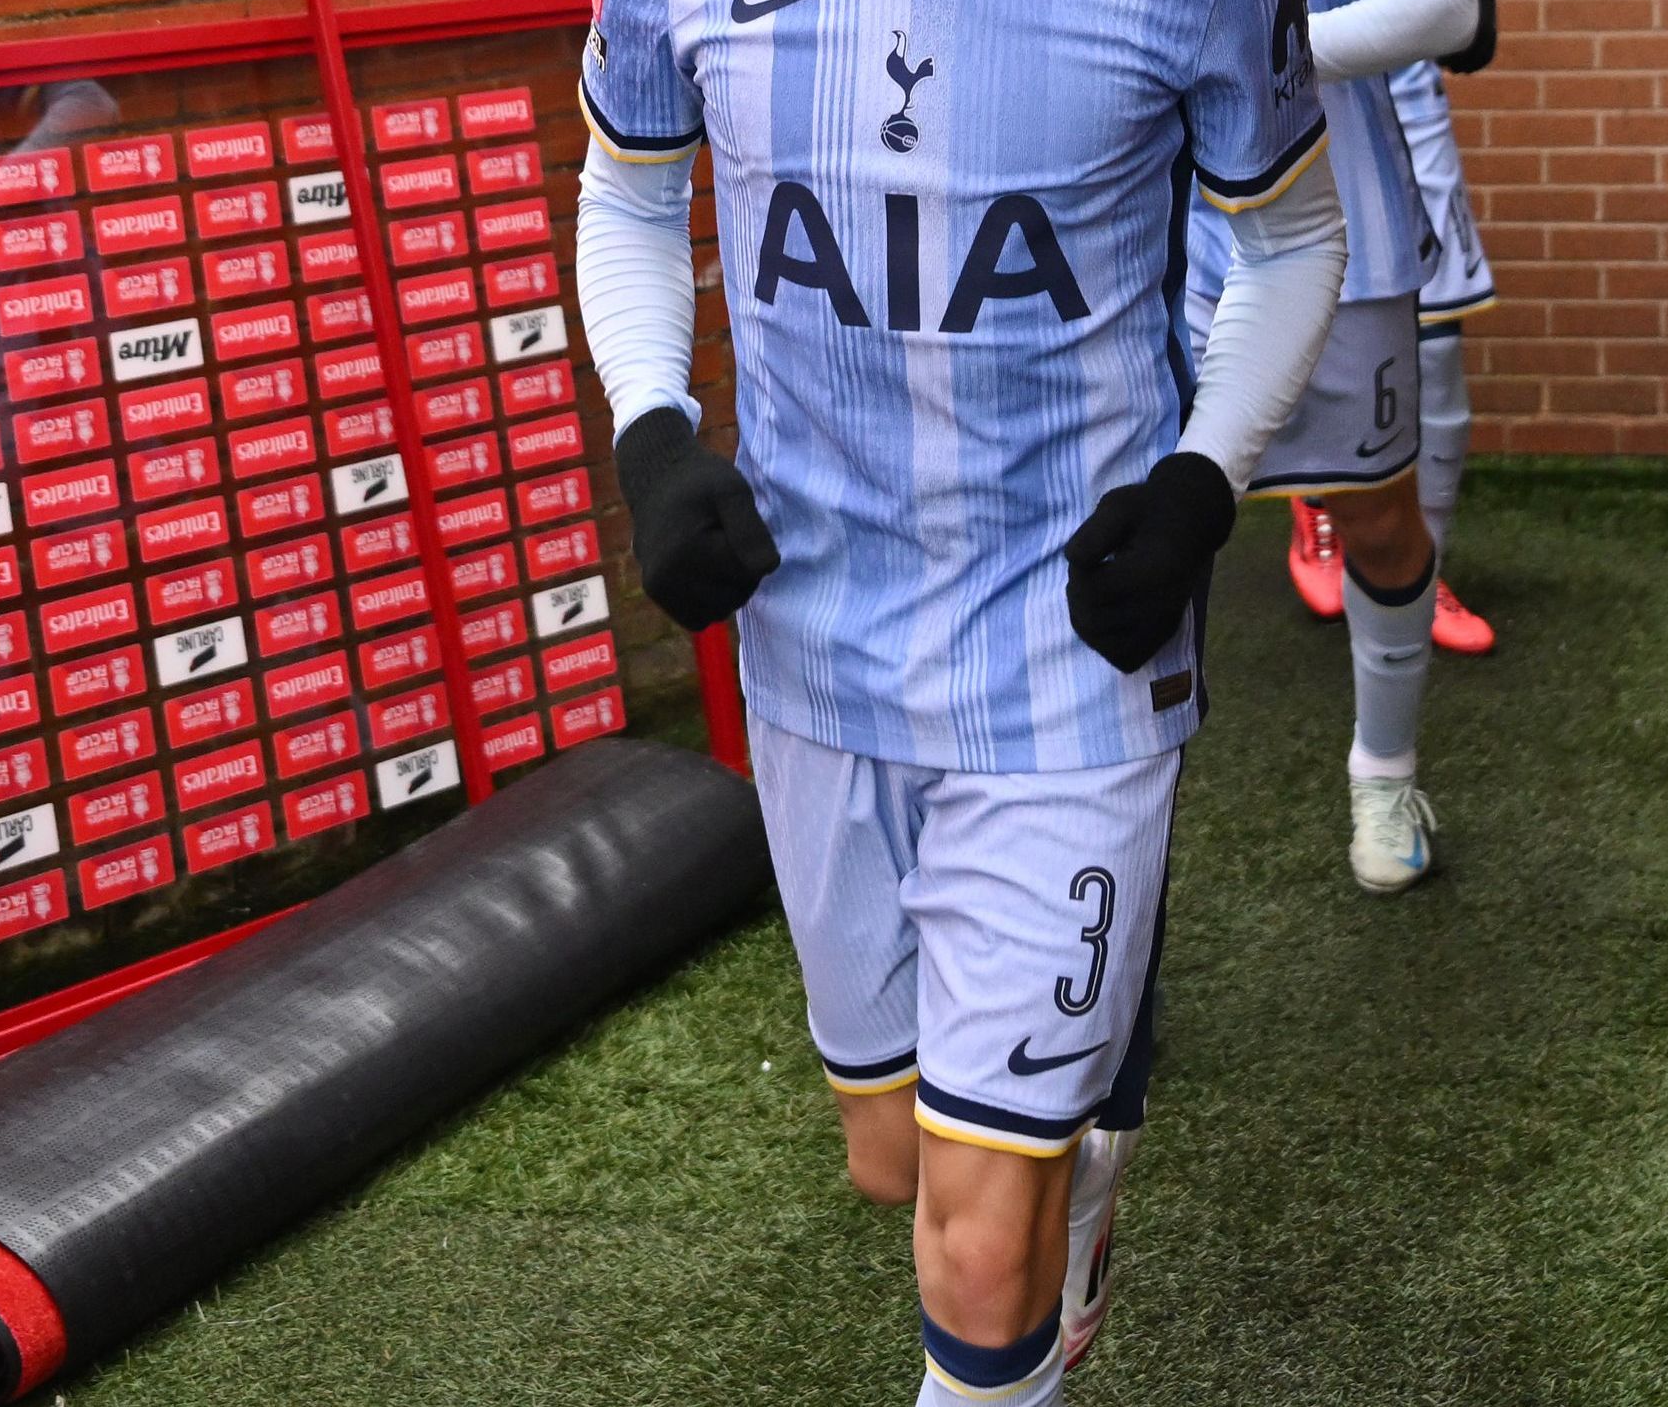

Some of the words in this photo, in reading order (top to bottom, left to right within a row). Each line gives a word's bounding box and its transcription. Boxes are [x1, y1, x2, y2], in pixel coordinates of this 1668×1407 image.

[464, 99, 528, 123] Emirates
[122, 148, 140, 161] FA
[192, 134, 266, 161] Emirates
[99, 150, 124, 165] CUP
[17, 162, 36, 175] FA
[387, 167, 453, 192] Emirates
[208, 197, 232, 212] CUP
[230, 195, 246, 208] FA
[100, 208, 178, 237] Emirates
[481, 209, 544, 235] Emirates
[2, 228, 28, 243] CUP
[27, 226, 45, 239] FA
[216, 258, 240, 272] CUP
[238, 255, 255, 268] FA
[754, 180, 1091, 334] AIA
[116, 275, 142, 290] CUP
[140, 272, 157, 285] FA
[404, 280, 470, 308] Emirates
[2, 287, 85, 318] Emirates
[218, 313, 292, 343] Emirates
[117, 329, 192, 362] Mitre
[20, 357, 46, 373] CUP
[44, 353, 63, 367] FA
[234, 376, 257, 392] CUP
[256, 373, 272, 387] FA
[1374, 356, 1396, 429] 6
[126, 391, 204, 423] Emirates
[29, 418, 55, 434] CUP
[53, 415, 71, 429] FA
[235, 428, 309, 461] Emirates
[514, 424, 577, 454] Emirates
[143, 457, 168, 473] CUP
[166, 453, 183, 467] FA
[29, 473, 111, 508] Emirates
[273, 490, 289, 503] FA
[251, 493, 275, 509] CUP
[437, 500, 503, 532] Emirates
[144, 509, 221, 544] Emirates
[47, 542, 73, 559] CUP
[71, 538, 89, 552] FA
[260, 554, 284, 570] CUP
[282, 550, 298, 564] FA
[161, 579, 186, 596] CUP
[184, 575, 201, 589] FA
[356, 578, 425, 613] Emirates
[47, 597, 129, 635] Emirates
[269, 612, 292, 629] CUP
[291, 608, 307, 622] FA
[175, 624, 224, 653] CARLING
[548, 642, 610, 676] Emirates
[65, 668, 91, 686] CUP
[89, 663, 108, 678] FA
[271, 663, 344, 700] Emirates
[179, 701, 204, 719] CUP
[202, 697, 220, 711] FA
[75, 732, 101, 750] CUP
[99, 727, 117, 742] FA
[287, 733, 311, 750] CUP
[309, 728, 326, 743] FA
[181, 752, 258, 793] Emirates
[108, 791, 126, 806] FA
[297, 793, 320, 811] CUP
[319, 789, 335, 803] FA
[84, 796, 110, 814] CUP
[198, 826, 223, 844] CUP
[221, 820, 238, 835] FA
[94, 860, 120, 879] CUP
[118, 854, 136, 870] FA
[9, 890, 28, 906] FA
[1053, 865, 1116, 1017] 3
